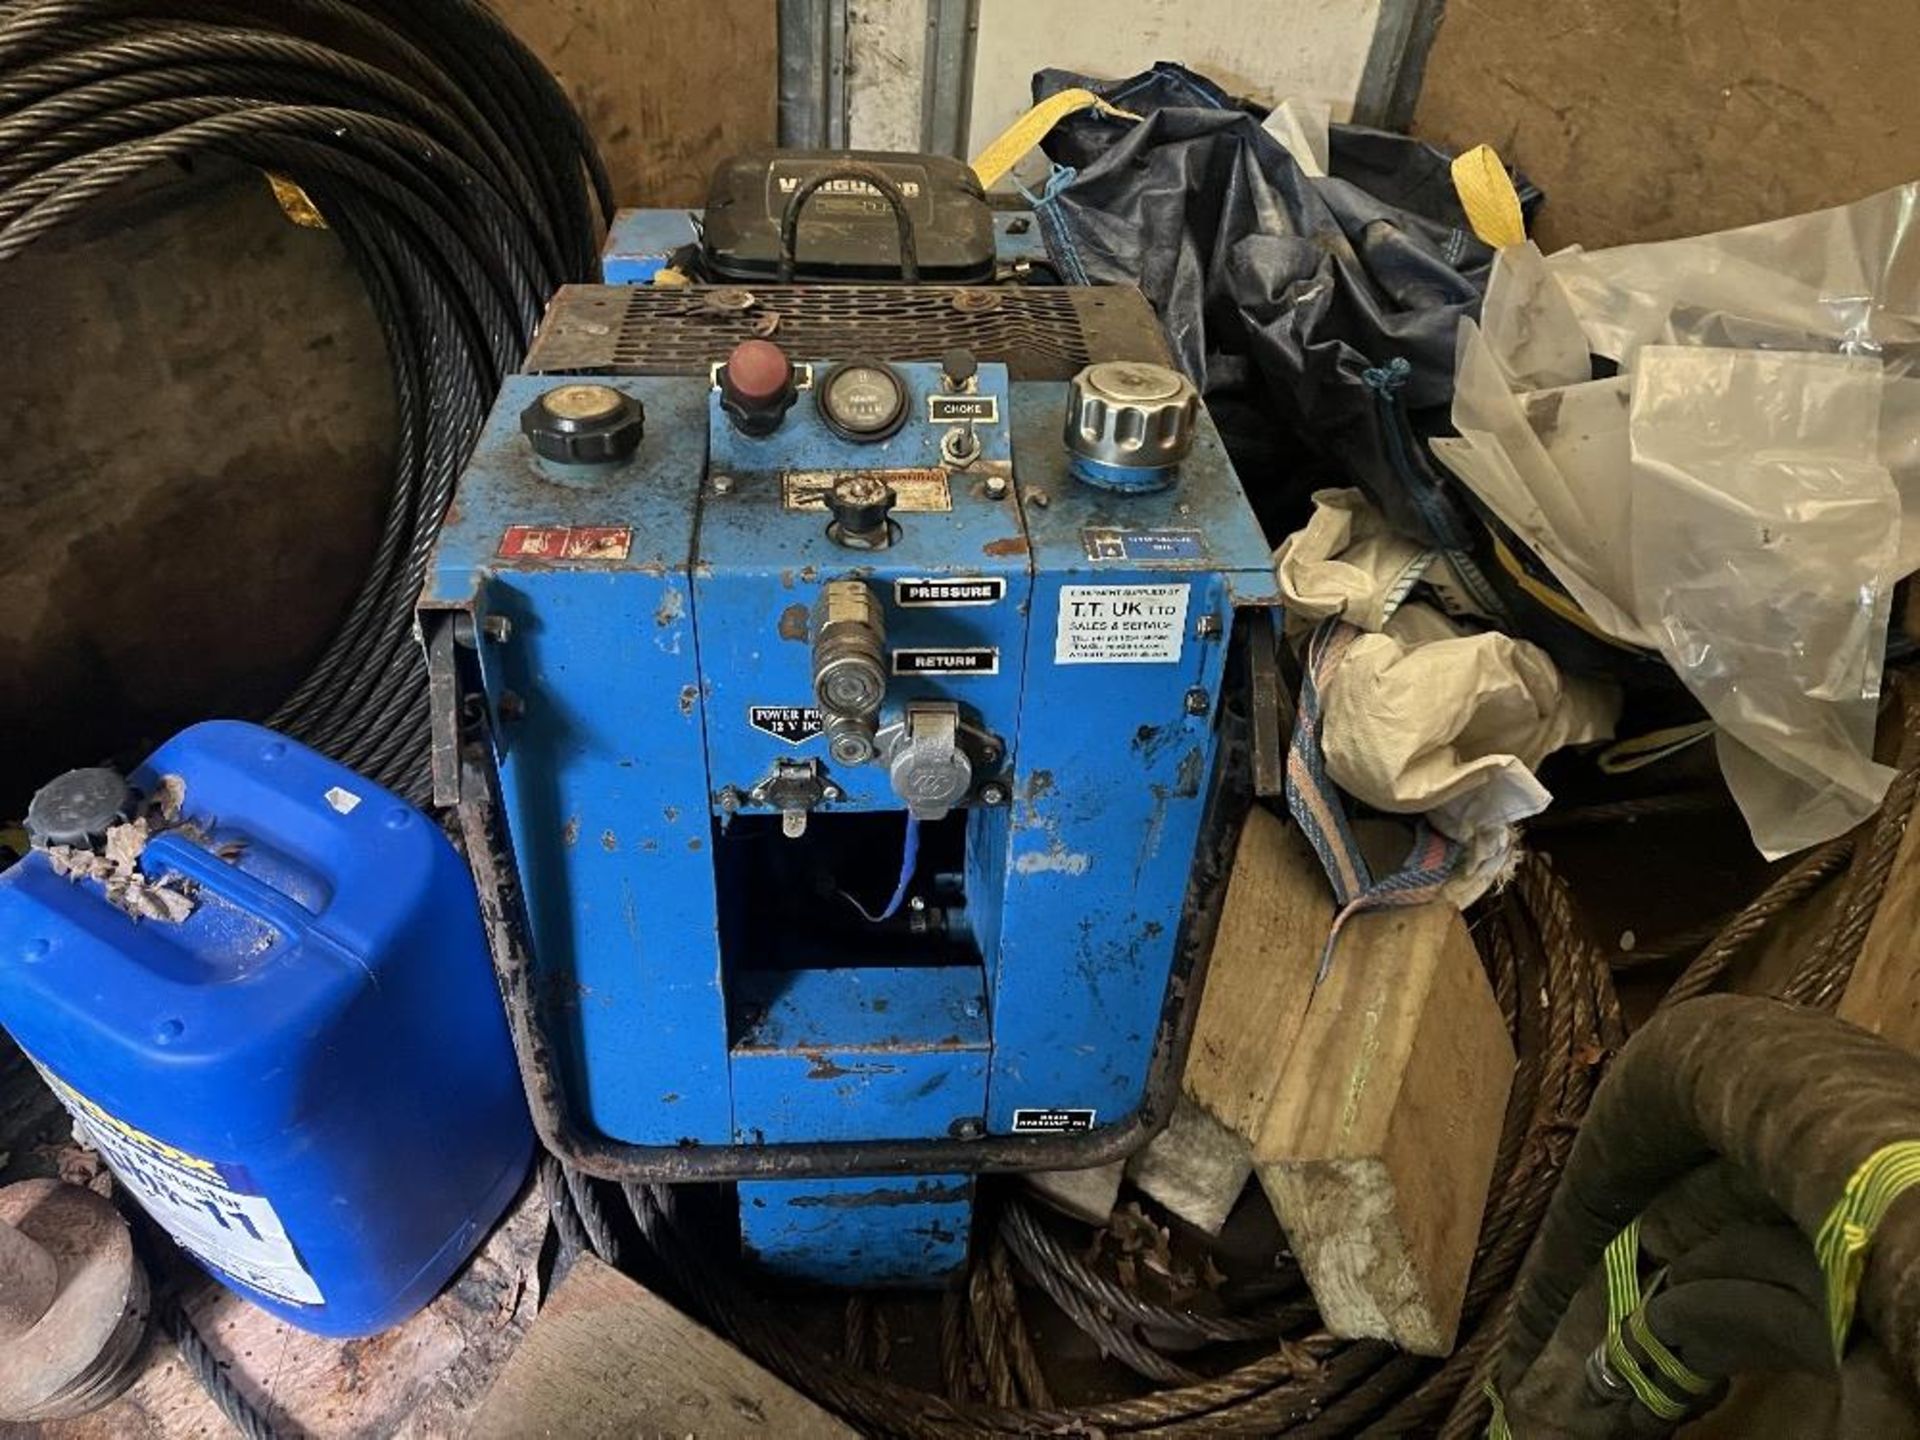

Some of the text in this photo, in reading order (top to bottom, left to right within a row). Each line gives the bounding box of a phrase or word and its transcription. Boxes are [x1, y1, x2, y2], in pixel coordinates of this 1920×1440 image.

[944, 404, 982, 414] CHOKE
[909, 585, 992, 598] PRESSURE
[1112, 601, 1142, 617] UK
[1068, 620, 1173, 631] SALES & SERVICE
[915, 656, 977, 668] RETURN
[756, 709, 800, 721] POWER
[787, 720, 798, 731] V
[802, 720, 821, 731] DC
